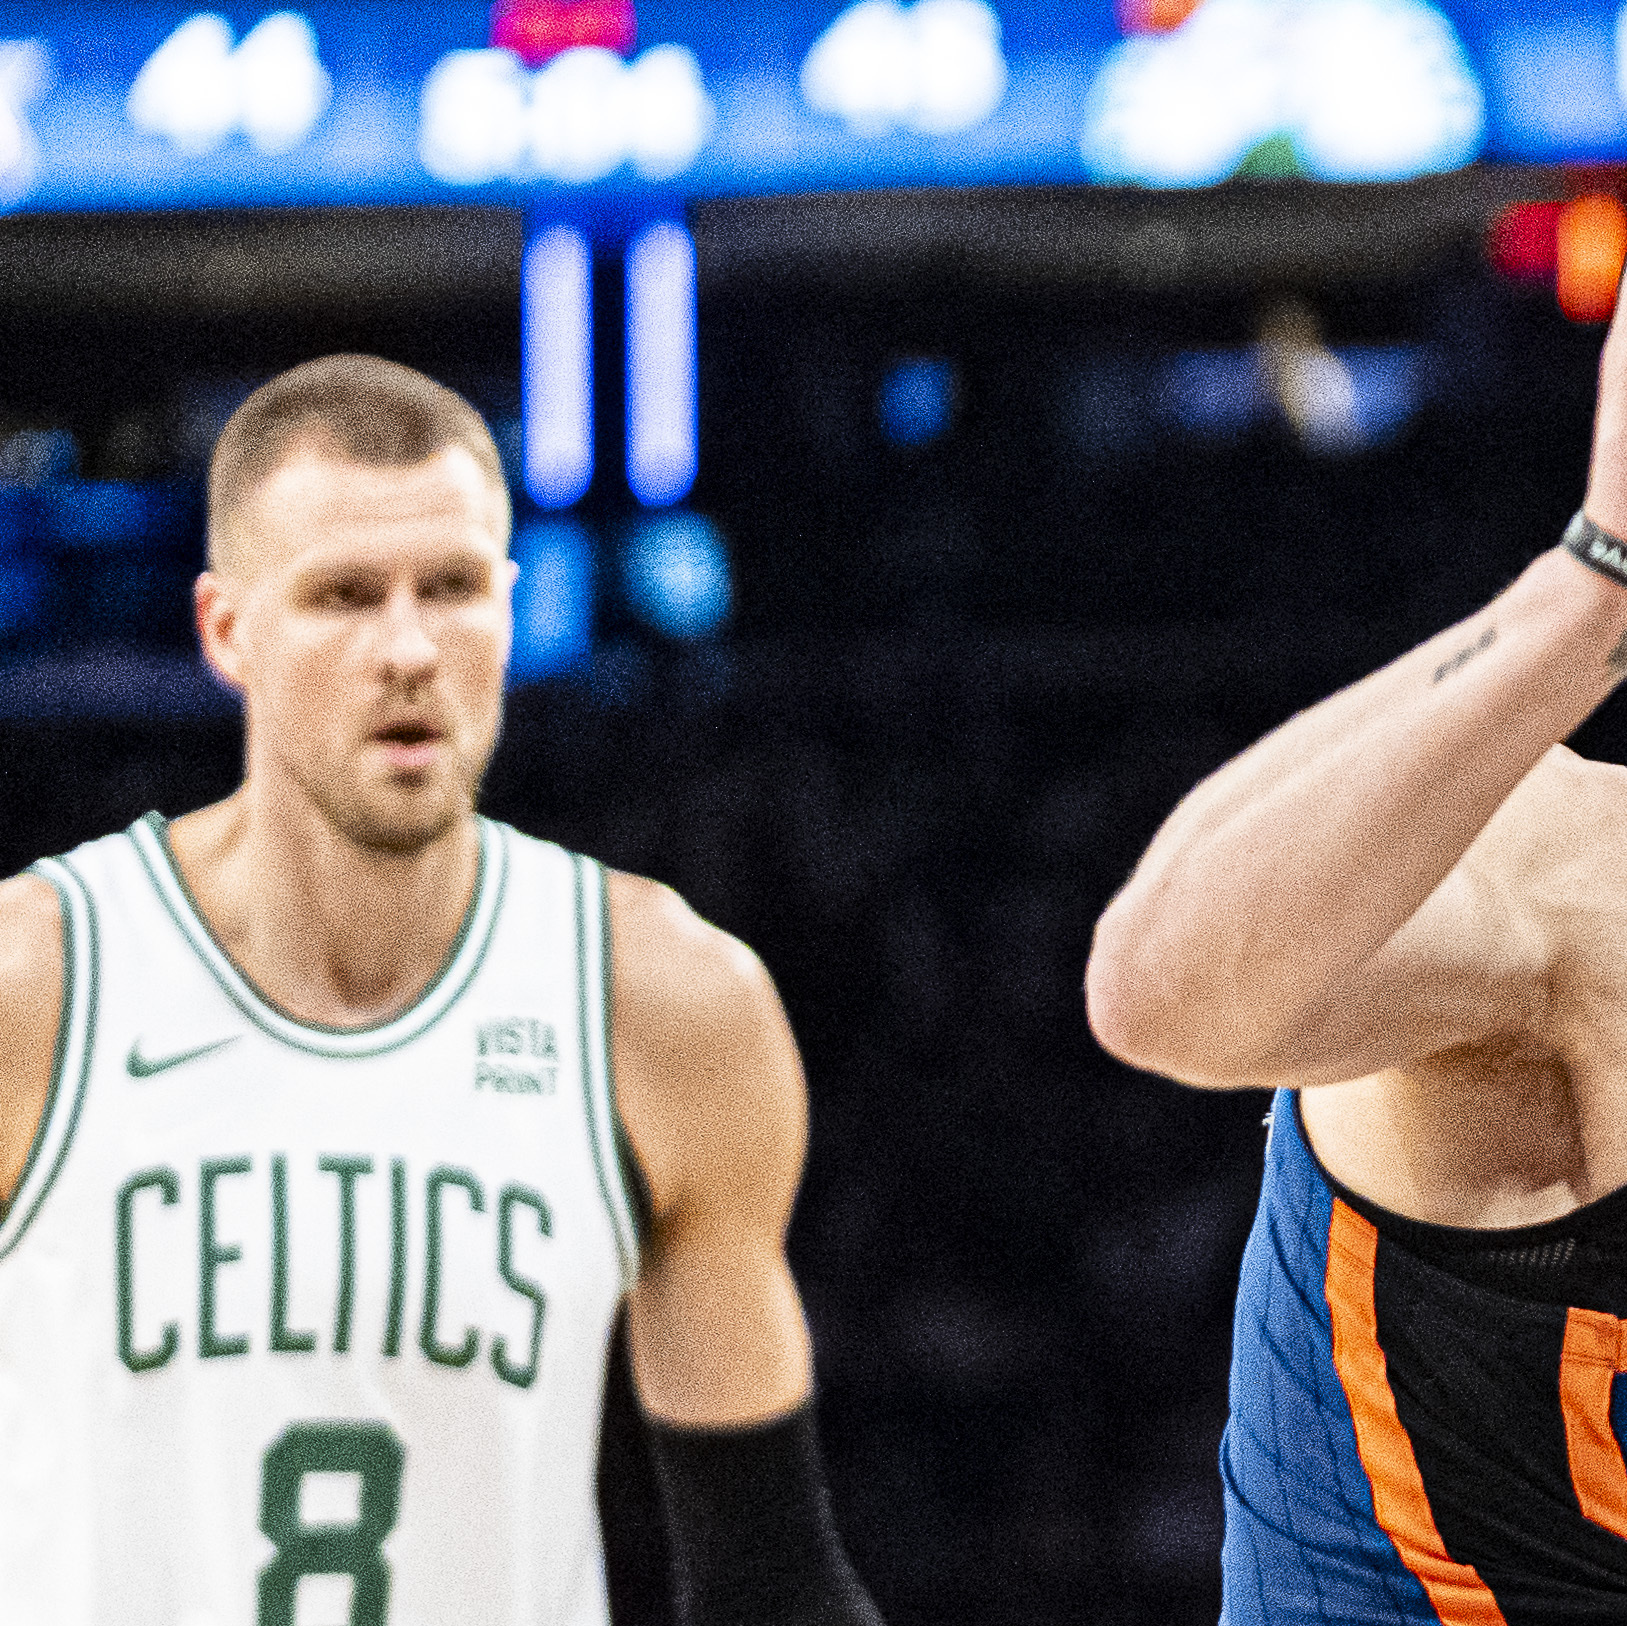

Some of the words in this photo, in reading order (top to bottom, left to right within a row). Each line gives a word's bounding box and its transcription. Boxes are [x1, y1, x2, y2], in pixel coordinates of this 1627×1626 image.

[475, 1016, 557, 1059] VISTA
[474, 1062, 557, 1096] PRINT
[114, 1152, 553, 1390] CELTICS
